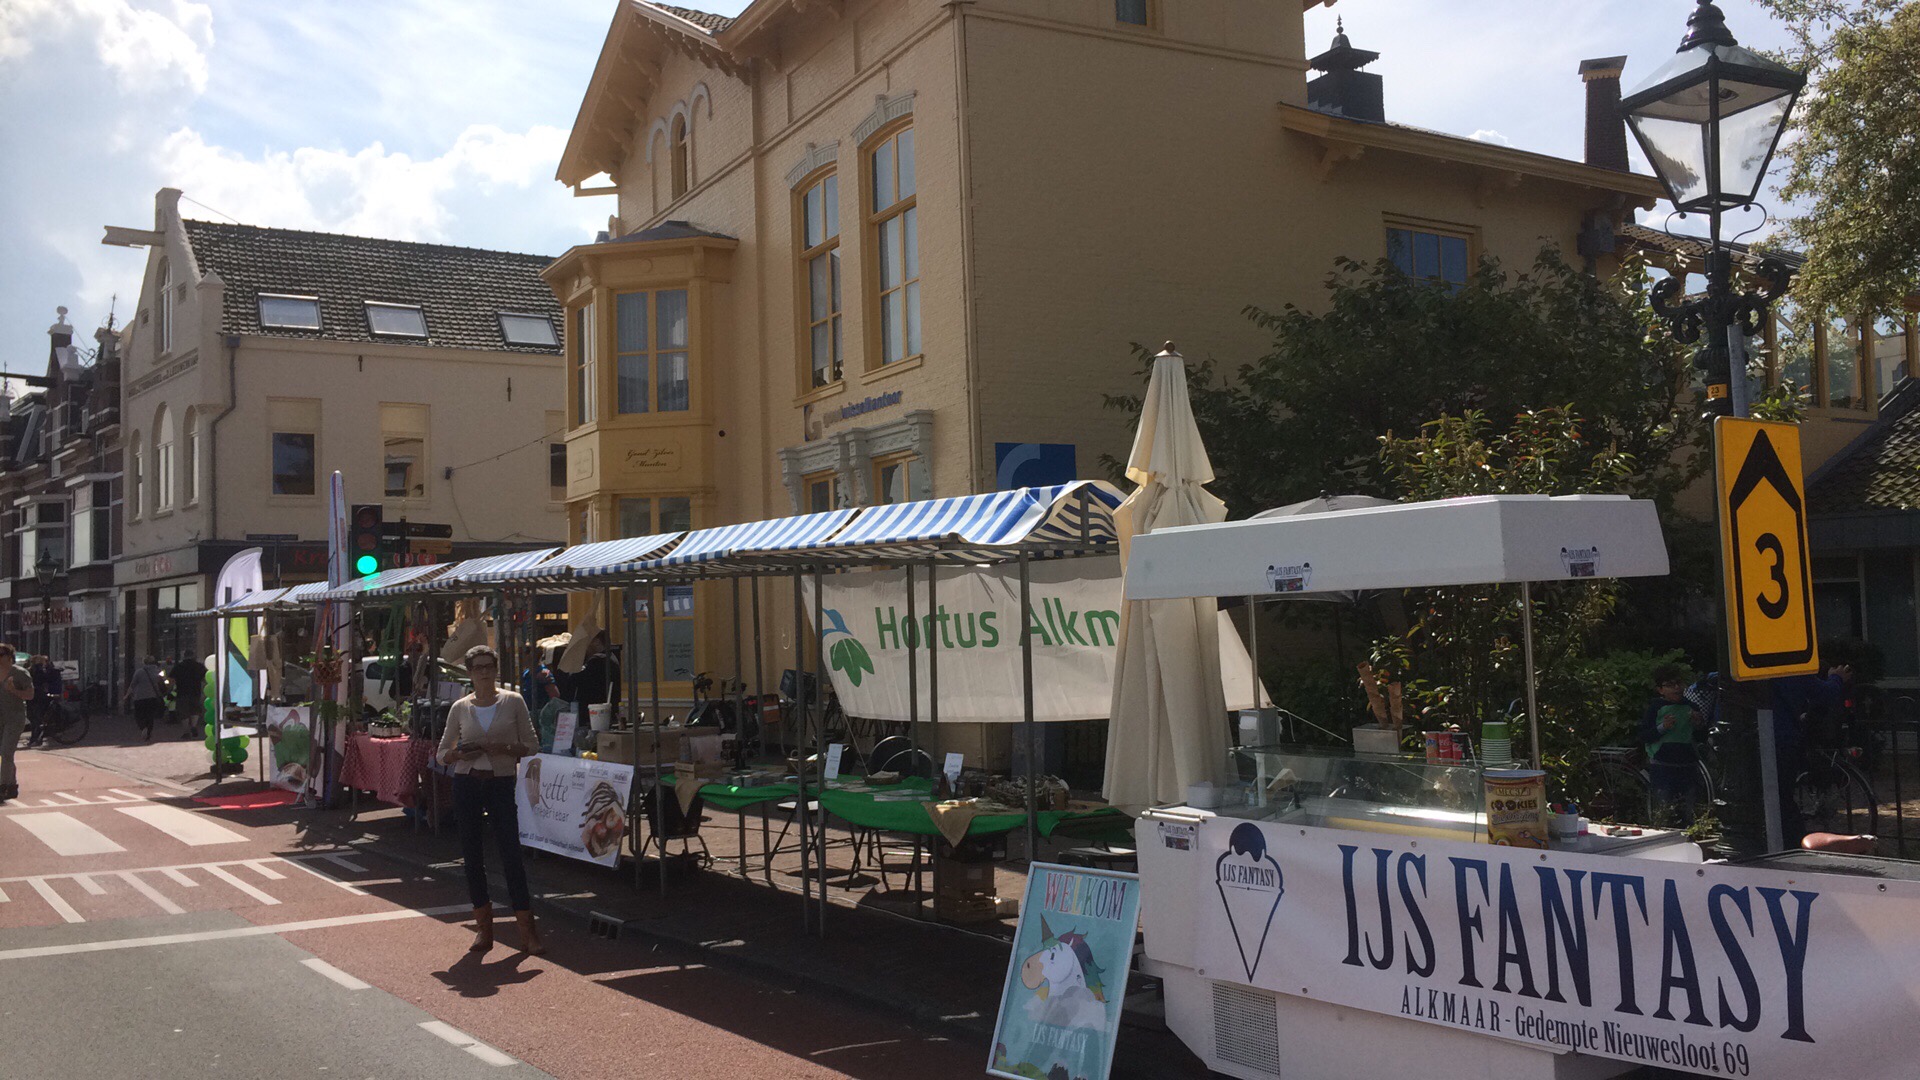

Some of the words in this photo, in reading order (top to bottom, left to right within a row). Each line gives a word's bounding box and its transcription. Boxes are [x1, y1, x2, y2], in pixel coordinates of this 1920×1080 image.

[1754, 532, 1790, 620] 3
[874, 604, 999, 650] Hortus
[1044, 871, 1128, 921] WELKOM
[1223, 863, 1236, 882] IJS
[1237, 865, 1275, 888] FANTASY
[1336, 844, 1436, 978] IJS
[1448, 856, 1819, 1044] FANTASY
[1048, 1027, 1089, 1053] FANTASY
[1401, 985, 1500, 1034] ALKMAAR
[1515, 1006, 1599, 1052] Gedempte
[1603, 1020, 1717, 1071] Nieuwesloot
[1723, 1042, 1750, 1076] 69
